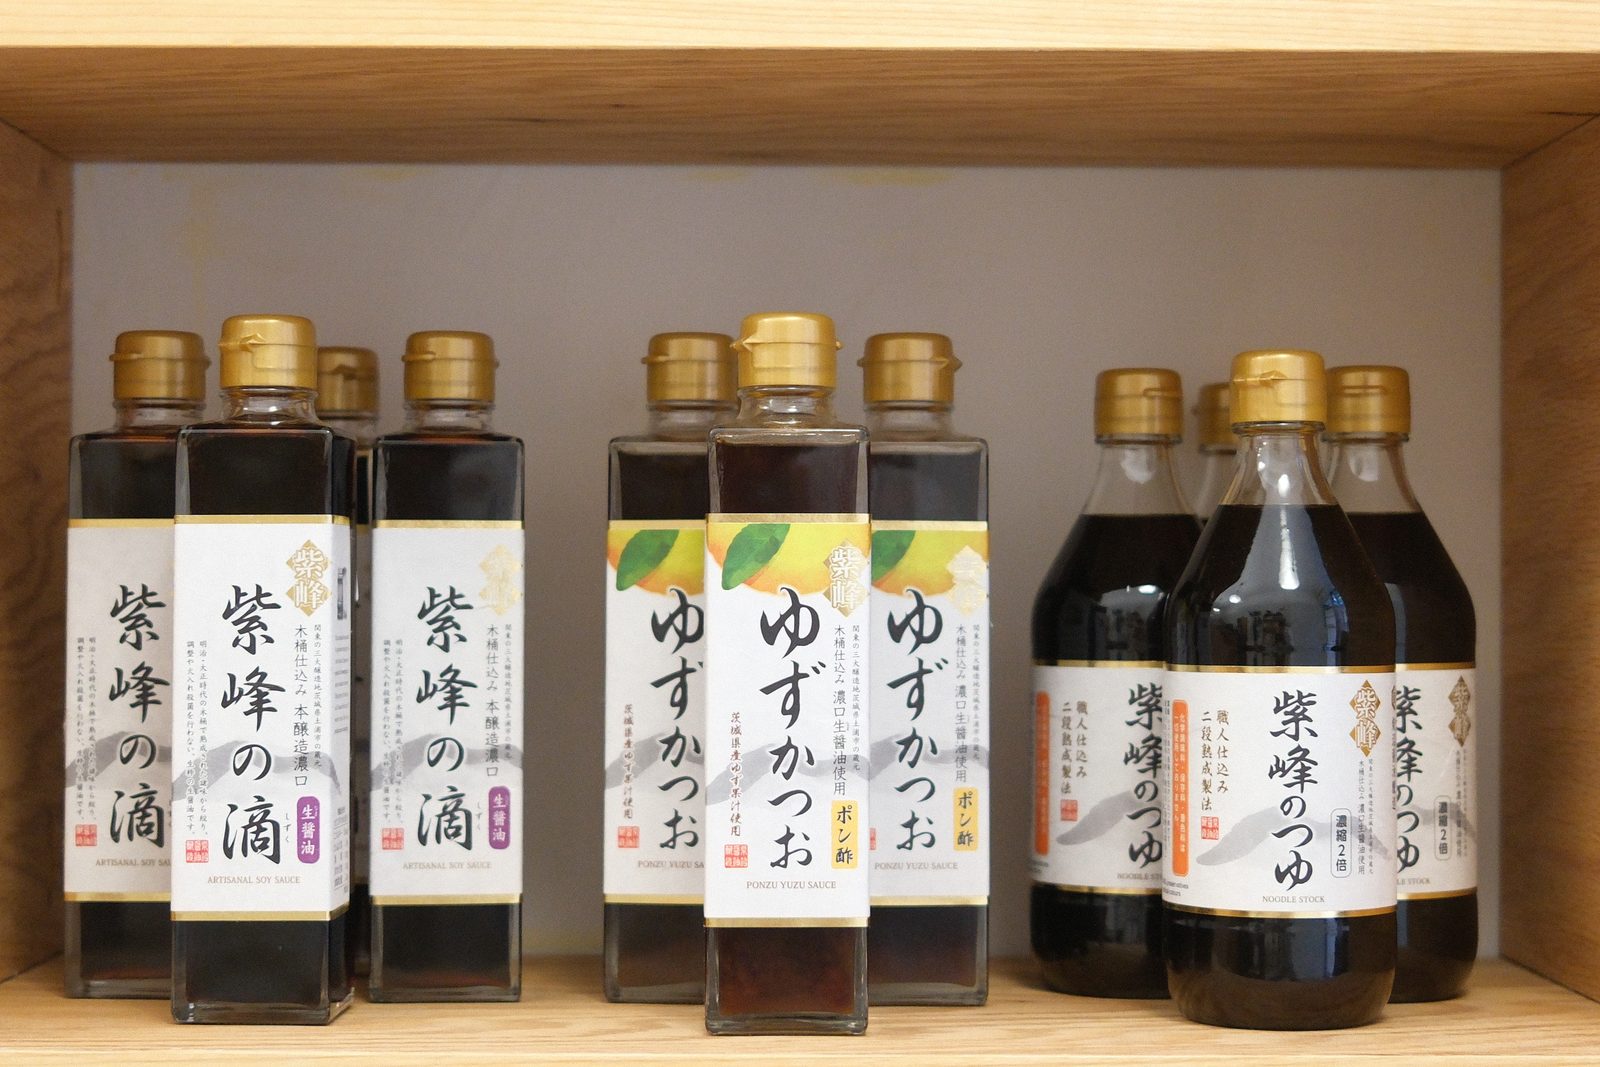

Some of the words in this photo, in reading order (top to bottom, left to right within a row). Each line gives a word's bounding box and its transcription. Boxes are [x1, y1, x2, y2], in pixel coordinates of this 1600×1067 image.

[292, 546, 325, 611] 紫峰
[294, 624, 309, 696] 木桶仕込み
[485, 624, 499, 692] 木桶仕込み
[833, 624, 846, 684] 木桶仕込み
[109, 583, 170, 848] 紫峰の滴
[221, 583, 286, 865] 紫峰の滴
[293, 703, 309, 786] 本醸造濃口
[416, 585, 478, 851] 紫峰の滴
[650, 587, 704, 849] ゆずかつお
[759, 586, 827, 869] ゆずかつお
[887, 588, 949, 850] ゆずかつお
[1355, 686, 1378, 750] 紫峰
[730, 711, 742, 837] 茨城県産ゆず果汁使用
[1123, 682, 1162, 869] 紫峰のつゆ
[1200, 711, 1213, 812] 二段熟成製法
[1216, 709, 1230, 794] 職人仕込み
[957, 790, 974, 847] ポン酢
[1268, 689, 1319, 891] 紫峰のつゆ
[96, 858, 138, 867] ARTISANAL
[402, 861, 447, 870] ARTISANAL
[466, 860, 492, 869] SAUCE
[835, 804, 853, 865] ポン酢
[873, 862, 904, 870] PONZU
[906, 862, 930, 870] YUZU
[931, 862, 958, 870] SAUCE
[1335, 814, 1348, 872] 濃縮2倍
[207, 875, 253, 884] ARTISANAL
[255, 875, 272, 884] SOY
[274, 875, 301, 884] SAUCE
[746, 880, 778, 889] PONZU
[780, 880, 806, 889] YUZU
[807, 880, 837, 889] SAUCE
[1262, 895, 1297, 904] NOODLE
[1299, 895, 1325, 904] STOCK
